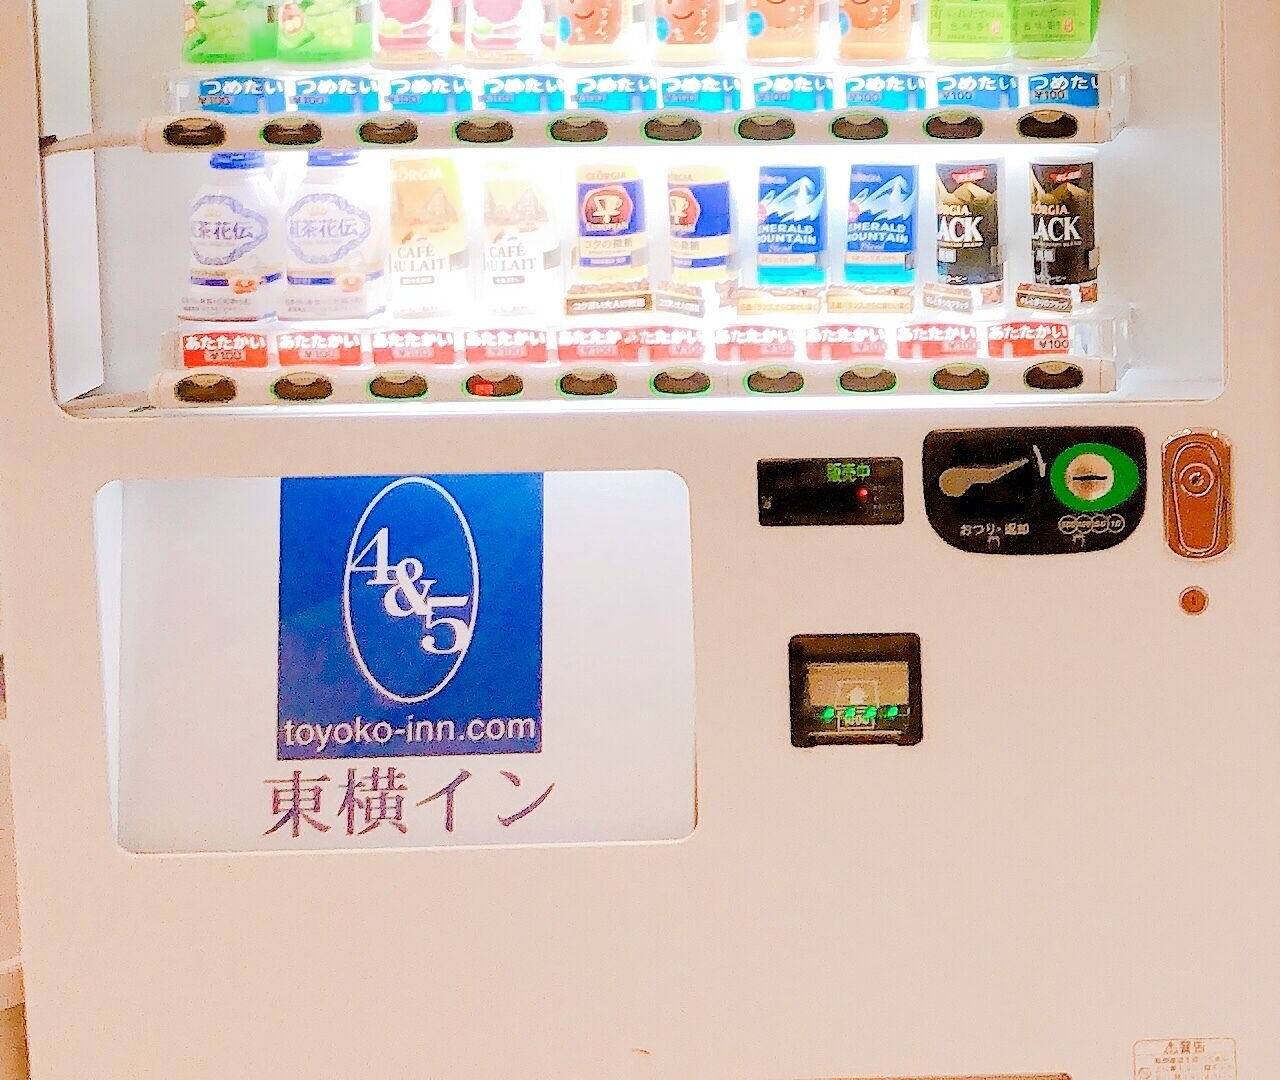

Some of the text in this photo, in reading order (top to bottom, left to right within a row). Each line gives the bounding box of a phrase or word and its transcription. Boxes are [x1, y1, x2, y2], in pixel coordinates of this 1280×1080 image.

[202, 78, 285, 95] つめたい
[297, 78, 378, 95] つめたい
[846, 77, 925, 93] つめたい
[938, 76, 1017, 90] つめたい
[943, 91, 973, 100] ¥100
[1035, 91, 1064, 100] ¥100
[897, 324, 977, 342] あたたかい
[989, 324, 1068, 338] あたたかい
[184, 333, 267, 350] あたたかい
[279, 333, 360, 350] あたたかい
[1039, 339, 1069, 349] ¥100
[350, 526, 472, 655] 4&5
[285, 715, 537, 753] toyoko-inn.com
[262, 767, 557, 839] 東横イン
